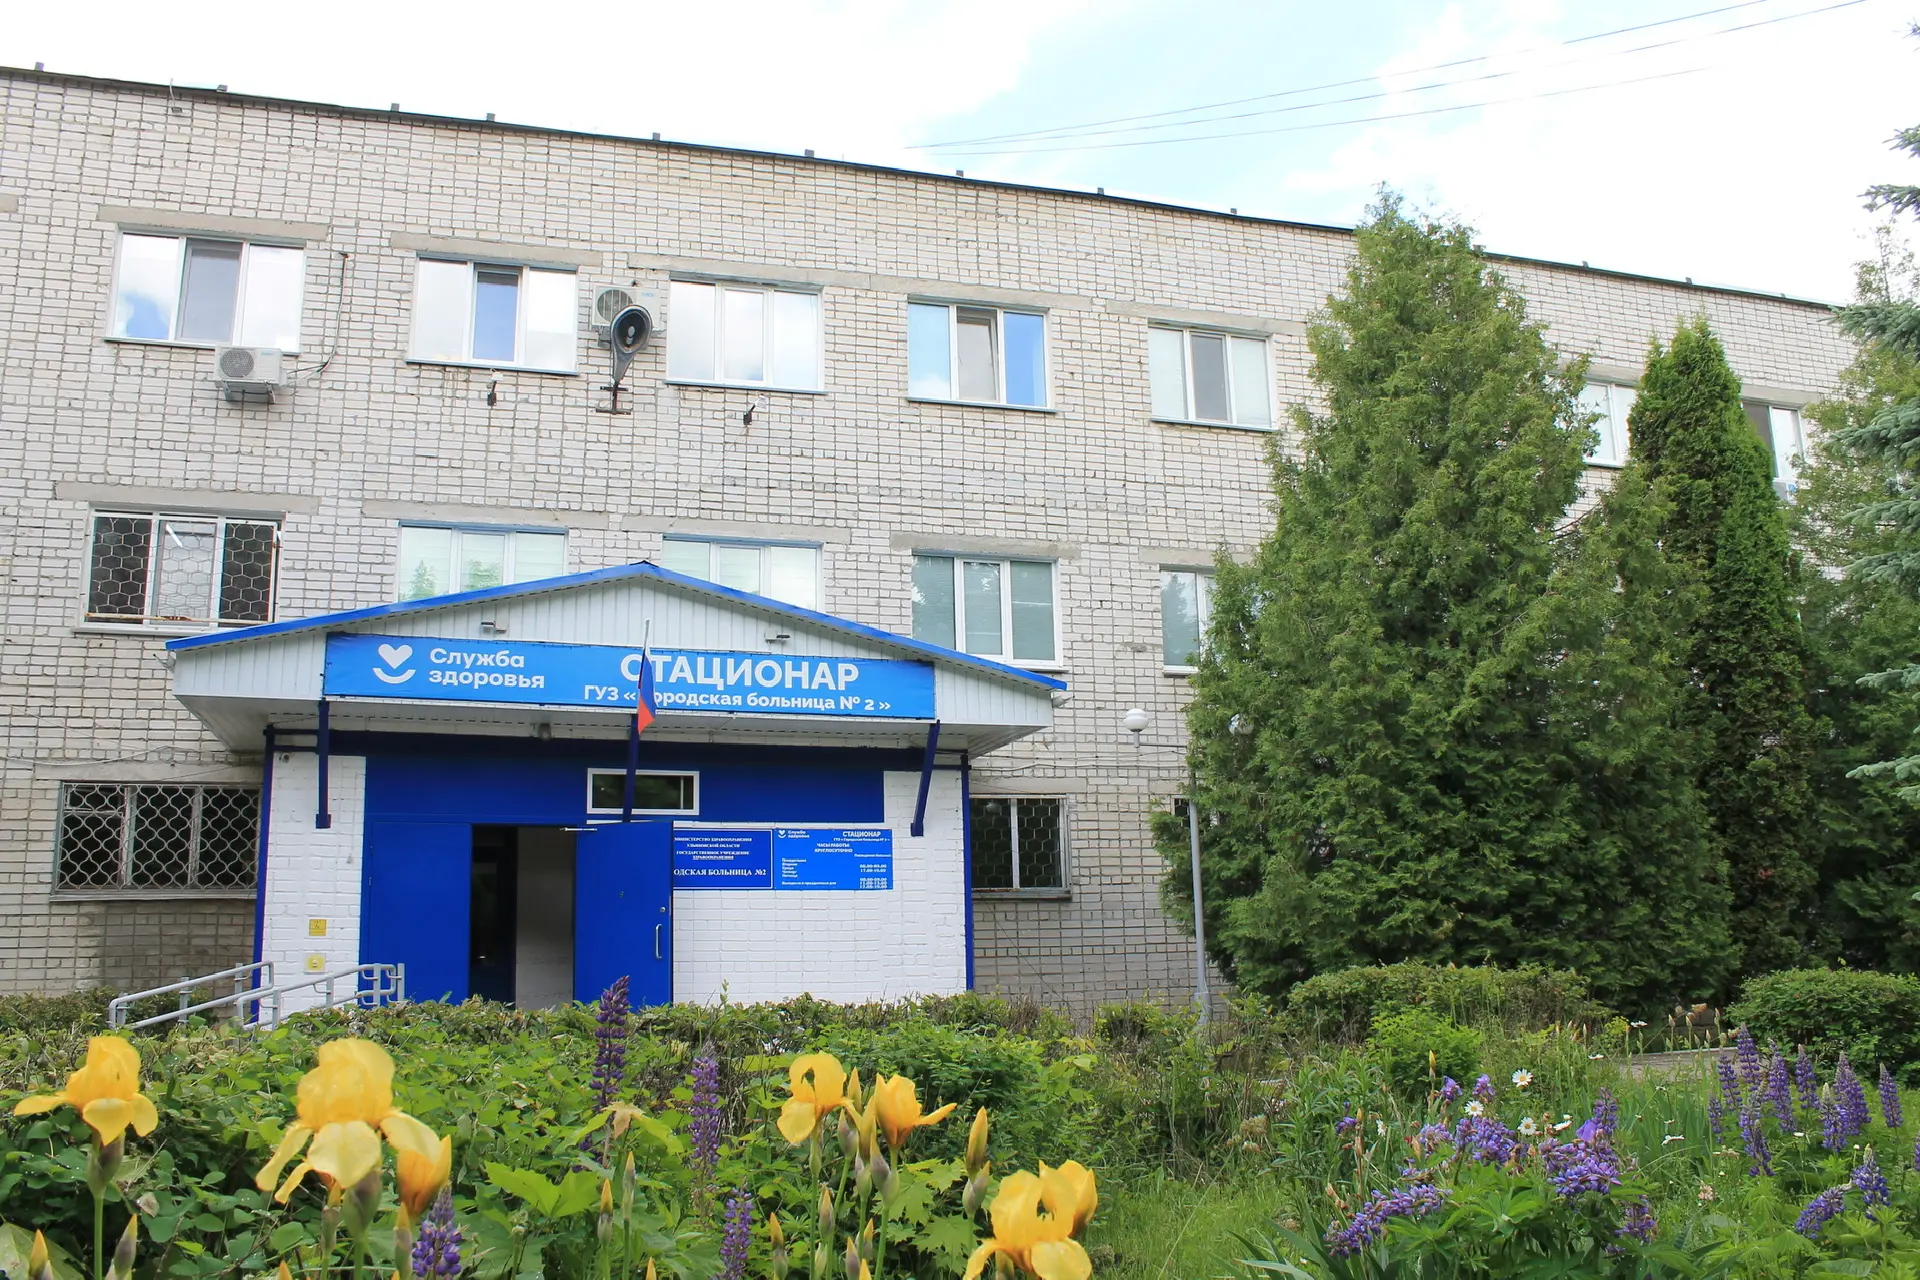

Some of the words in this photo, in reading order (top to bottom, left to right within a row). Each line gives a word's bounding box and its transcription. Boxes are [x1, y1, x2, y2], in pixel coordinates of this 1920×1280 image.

[429, 648, 525, 669] Служба
[428, 669, 545, 689] здоровья
[620, 653, 860, 691] СТАЦИОНАР
[584, 684, 619, 701] ГУЗ
[652, 690, 742, 707] ородская
[747, 690, 836, 712] больница
[864, 698, 875, 712] 2
[707, 869, 752, 877] БОЛЬНИЦА
